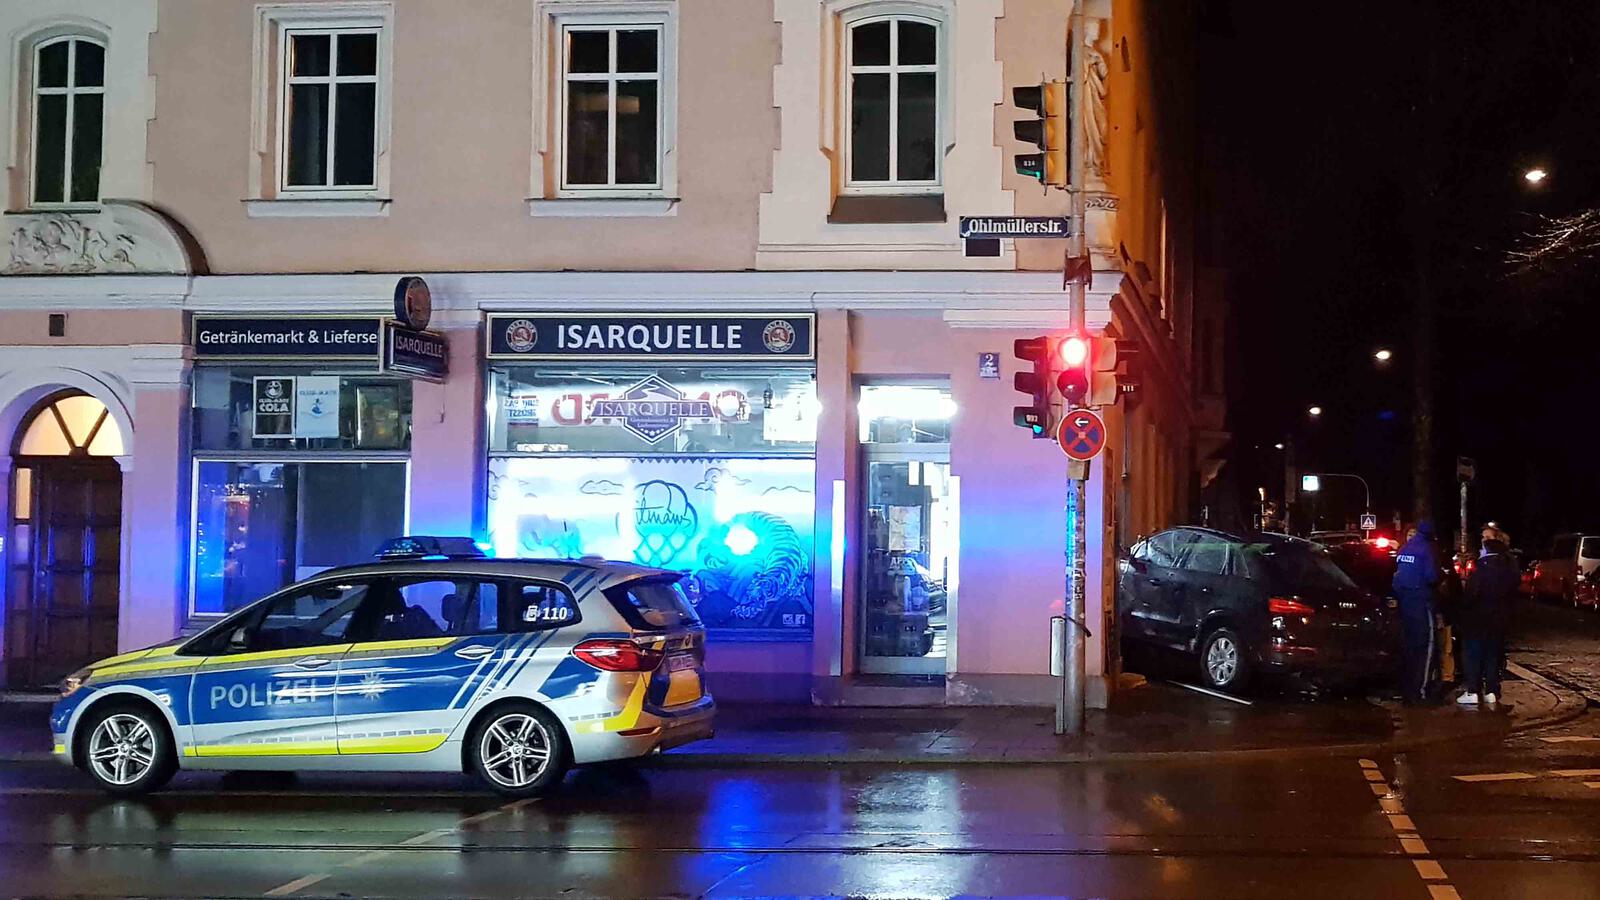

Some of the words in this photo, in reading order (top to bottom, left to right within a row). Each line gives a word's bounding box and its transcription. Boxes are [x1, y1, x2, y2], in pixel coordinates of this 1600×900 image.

[969, 218, 1062, 233] Ohlmüllerstr.
[200, 330, 304, 344] Getränkemarkt
[308, 330, 319, 344] &
[324, 330, 377, 344] Lieferse
[558, 324, 742, 352] ISARQUELLE
[395, 335, 443, 358] ISARQUELLE
[985, 353, 994, 367] 2
[259, 403, 289, 412] COLA
[599, 402, 708, 416] ISARQUELLE
[542, 607, 568, 620] 110
[210, 679, 317, 709] POLIZEI
